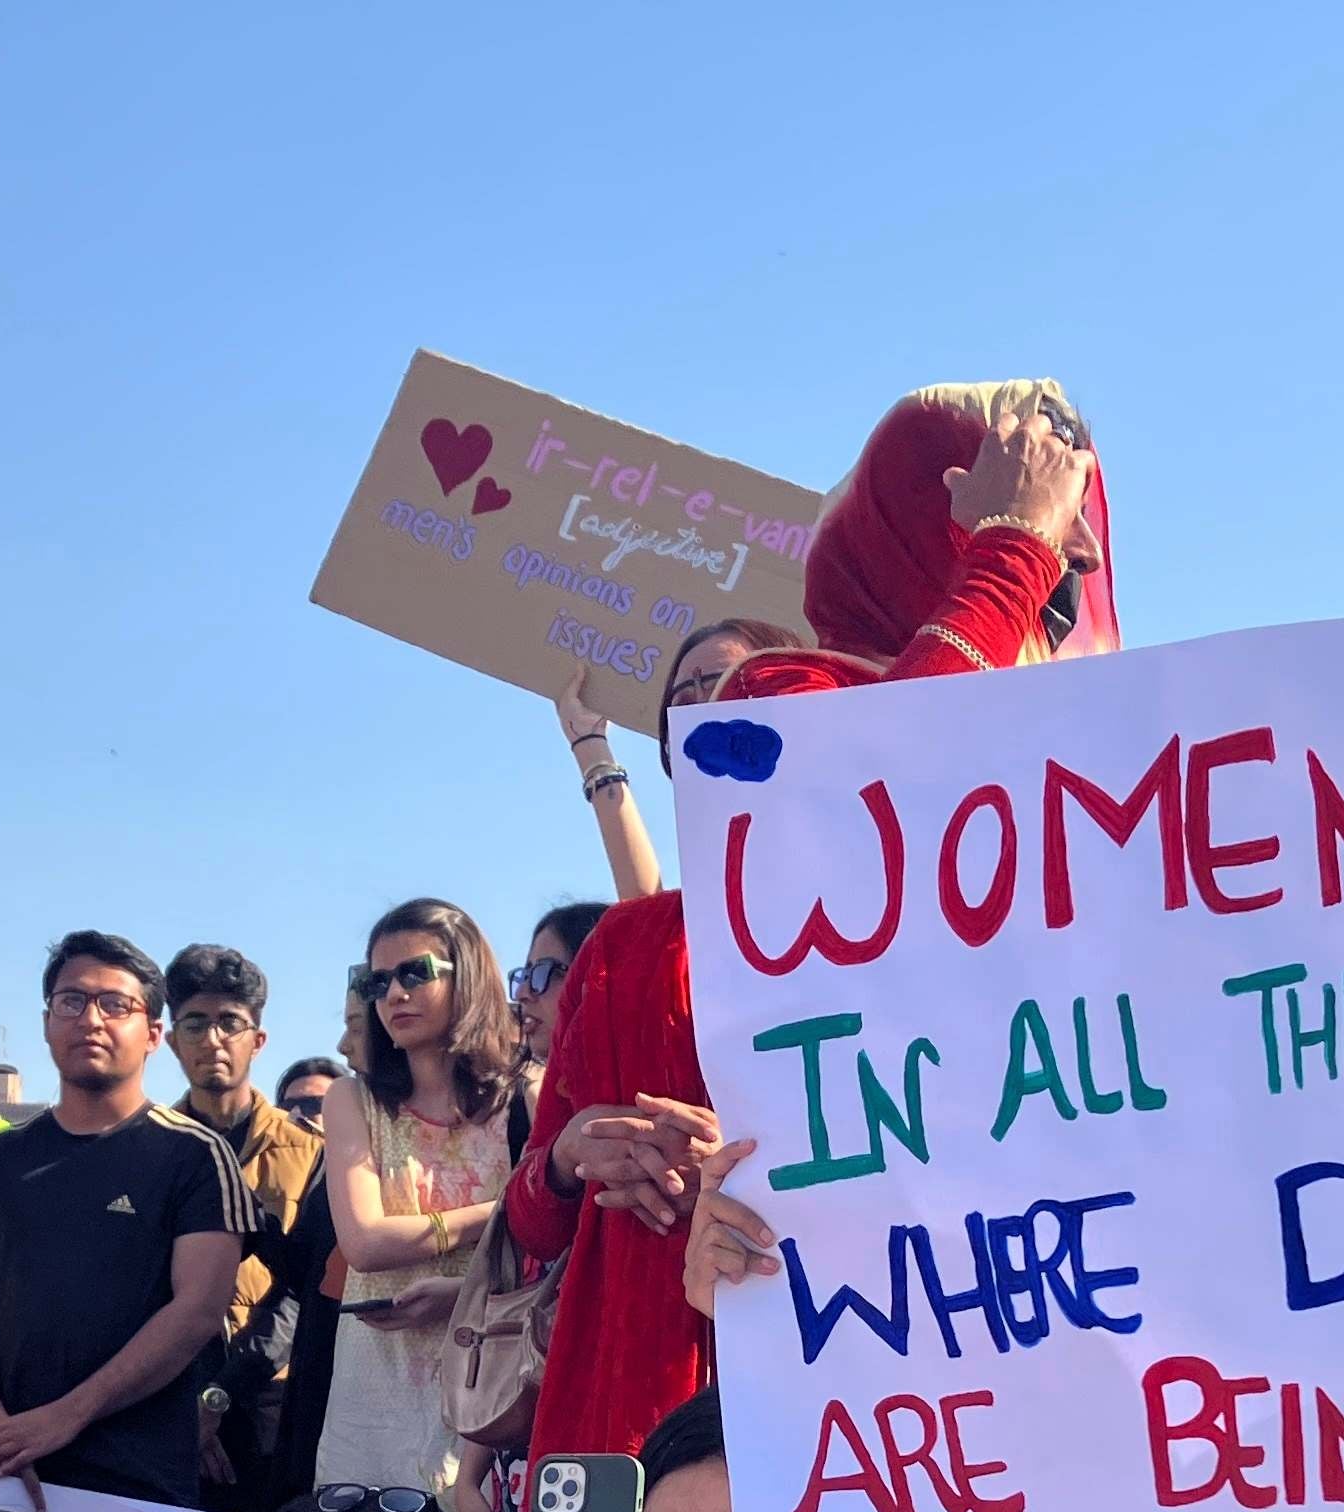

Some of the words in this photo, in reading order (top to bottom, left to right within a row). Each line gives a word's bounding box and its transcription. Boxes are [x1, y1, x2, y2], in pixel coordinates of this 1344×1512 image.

[502, 543, 638, 617] opinions
[649, 595, 696, 636] on
[544, 607, 662, 684] issues
[754, 1012, 942, 1191] IN
[991, 994, 1167, 1143] ALL
[779, 1191, 1144, 1365] WHERE
